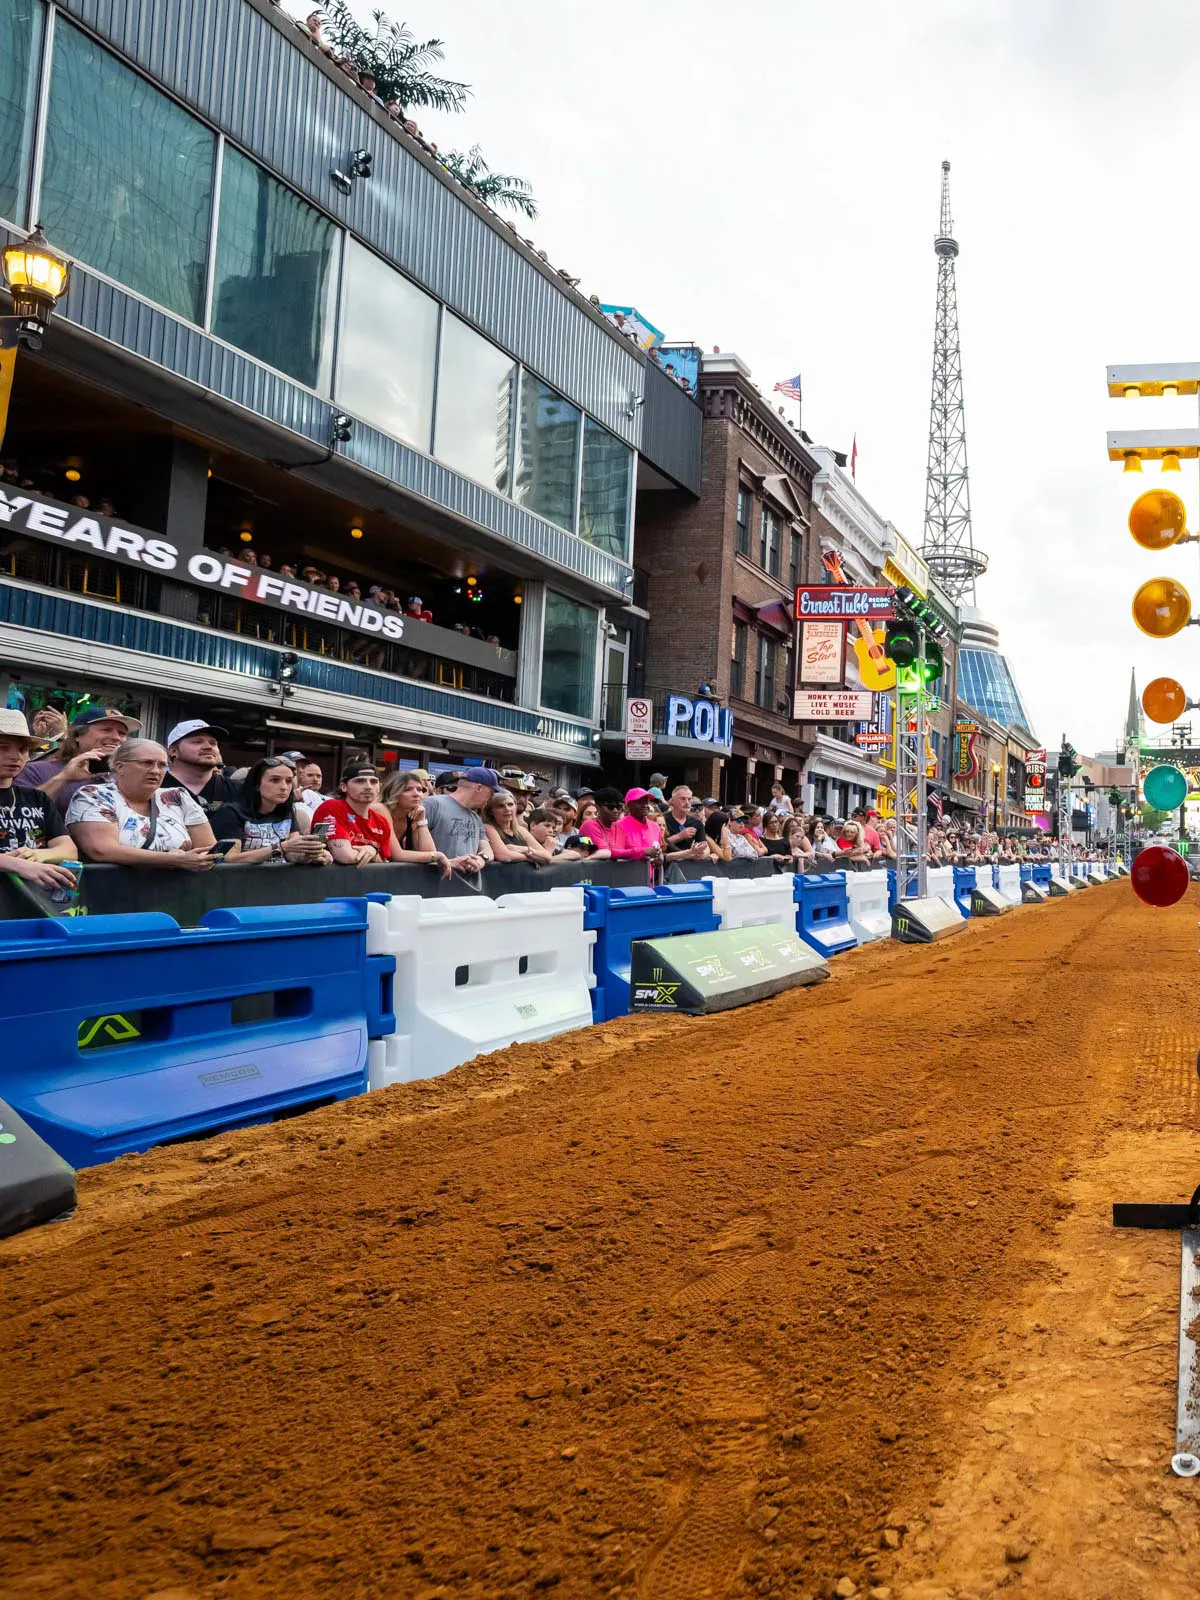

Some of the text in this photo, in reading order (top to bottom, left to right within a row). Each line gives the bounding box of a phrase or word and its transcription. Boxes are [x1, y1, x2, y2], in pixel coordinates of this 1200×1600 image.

[0, 489, 405, 639] YEARS OF FRIENDS
[800, 591, 869, 614] Ernest Tubb
[817, 640, 834, 653] Top
[1026, 764, 1045, 774] RIBS
[21, 806, 44, 819] OAK
[634, 986, 678, 1004] SMX
